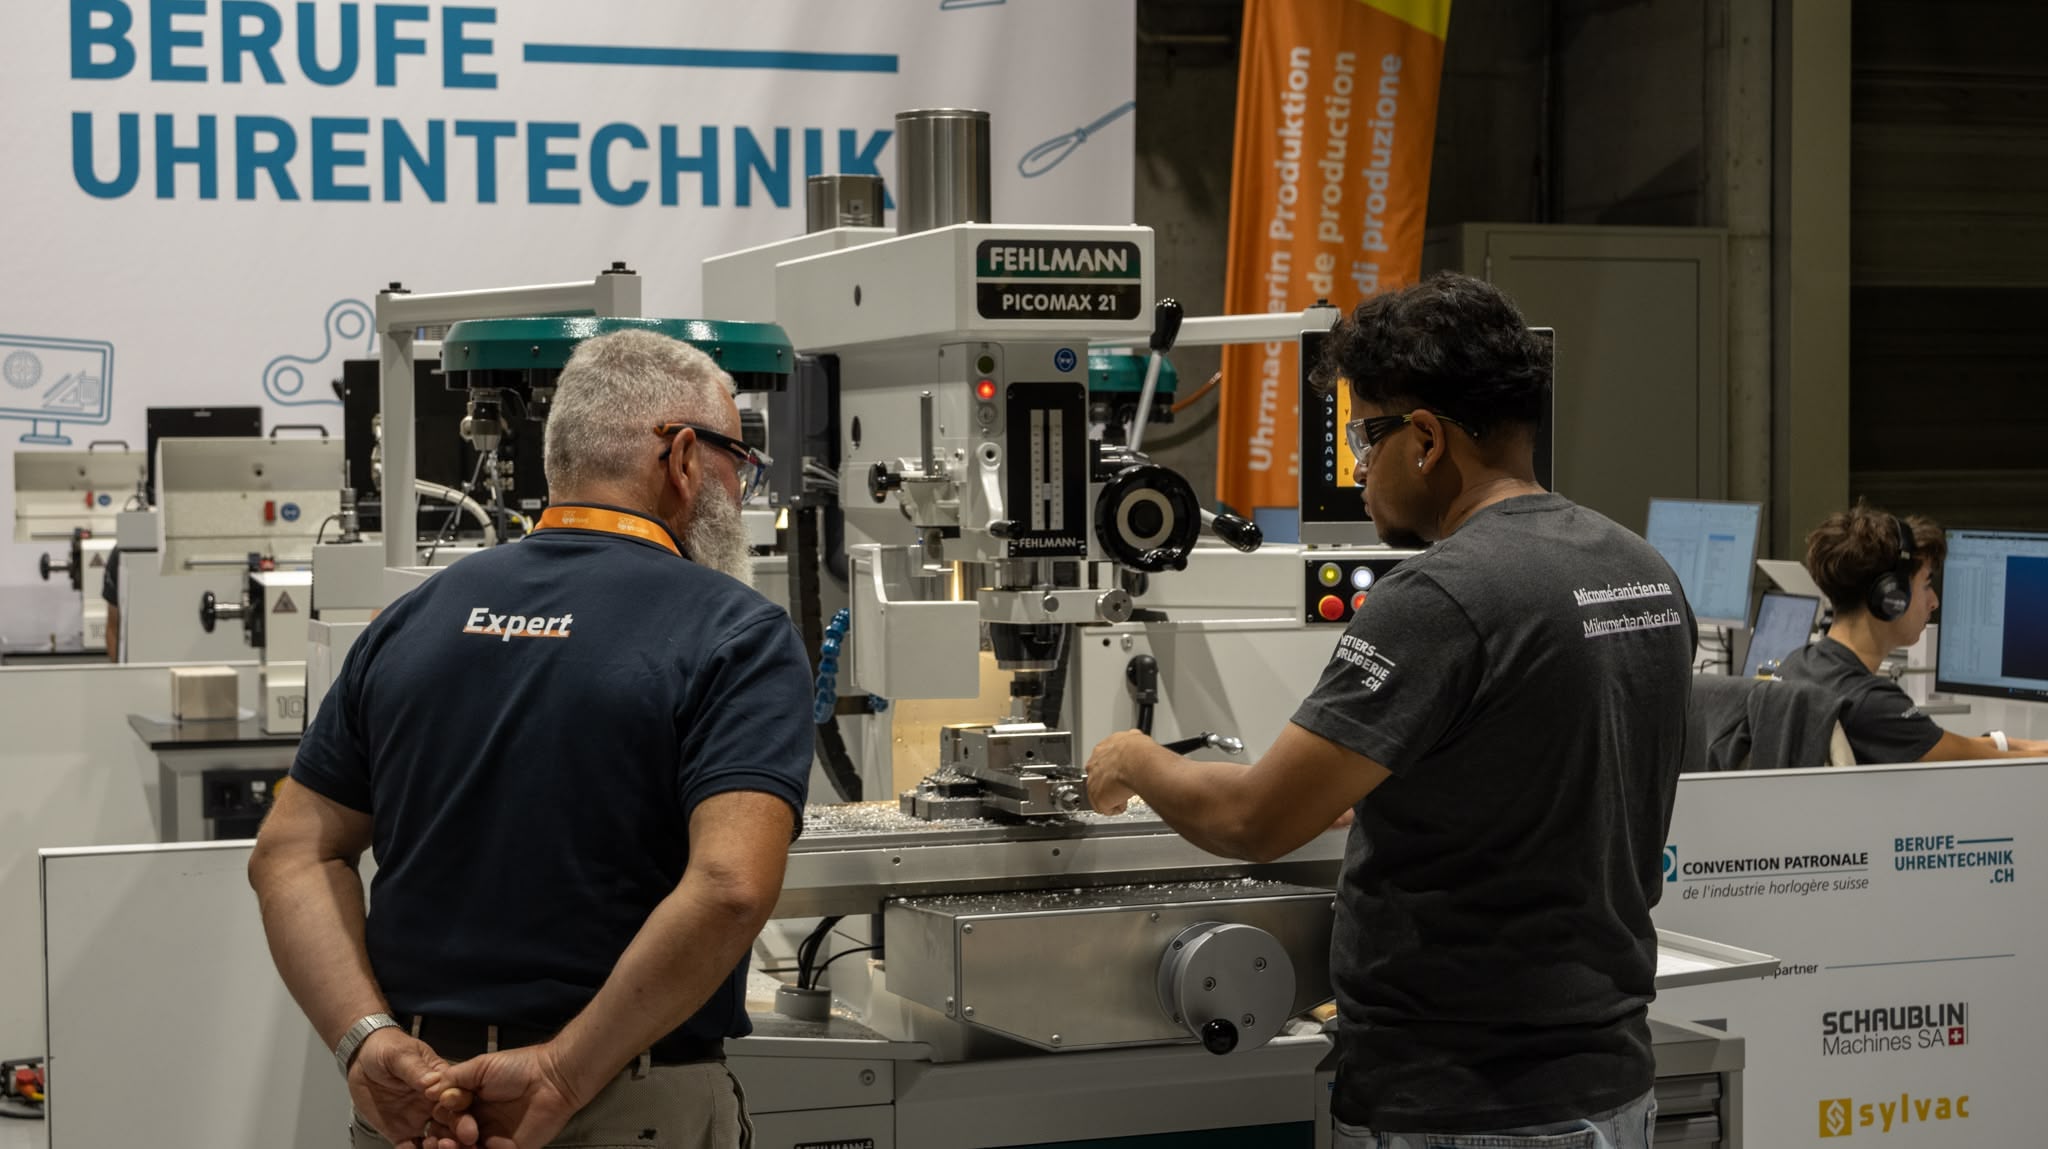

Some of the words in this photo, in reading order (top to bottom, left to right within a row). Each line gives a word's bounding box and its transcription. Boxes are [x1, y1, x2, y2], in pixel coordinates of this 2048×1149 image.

[70, 0, 498, 90] BERUFE
[72, 111, 896, 210] UHRENTECHNIK
[1269, 46, 1311, 242] Produktion
[1318, 51, 1356, 243] production
[1362, 53, 1403, 253] produzione
[990, 246, 1128, 272] FEHLMANN
[1306, 253, 1335, 295] de
[1352, 261, 1380, 295] di
[1002, 293, 1092, 311] PICOMAX
[1098, 294, 1116, 311] 21
[1248, 252, 1292, 472] Uhrmacerin
[1019, 537, 1077, 549] FEHLMANN
[465, 607, 574, 642] Expert
[1361, 676, 1382, 692] .CH
[1894, 835, 1954, 852] BERUFE
[1894, 850, 2014, 871] UHRENTECHNIK
[1682, 857, 1780, 875] CONVENTION
[1784, 852, 1869, 869] PATRONALE
[1990, 868, 2015, 884] .CH
[1682, 885, 1699, 900] de
[1702, 881, 1765, 898] l'industrie
[1769, 878, 1829, 897] horlogère
[1832, 876, 1869, 891] suisse
[1822, 1002, 1965, 1036] SCHAUBLIN
[1823, 1034, 1912, 1056] Machines
[1917, 1028, 1945, 1048] SA
[1859, 1093, 1969, 1133] sylvac
